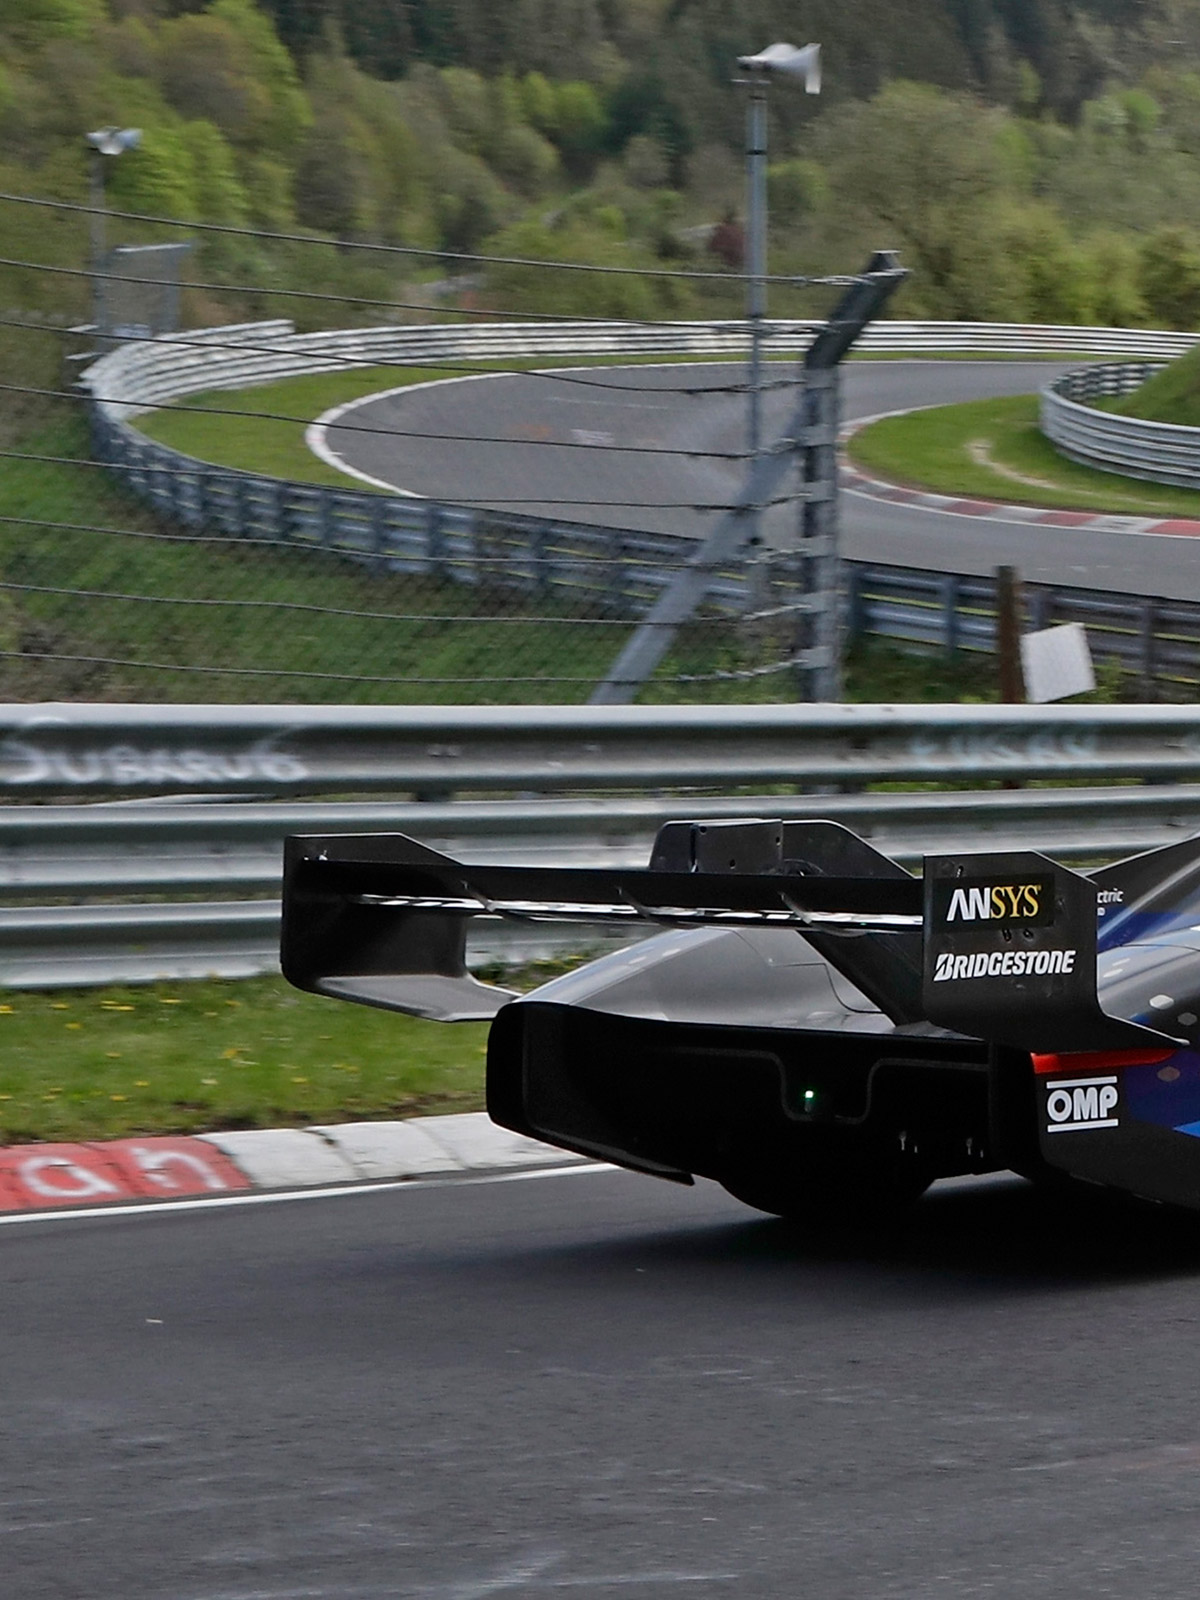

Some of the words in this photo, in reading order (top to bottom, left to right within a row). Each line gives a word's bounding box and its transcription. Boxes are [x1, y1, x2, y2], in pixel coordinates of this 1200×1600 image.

[946, 884, 1042, 922] ANSYS
[934, 950, 1076, 982] BRIDGESTONE
[1047, 1085, 1118, 1122] OMP
